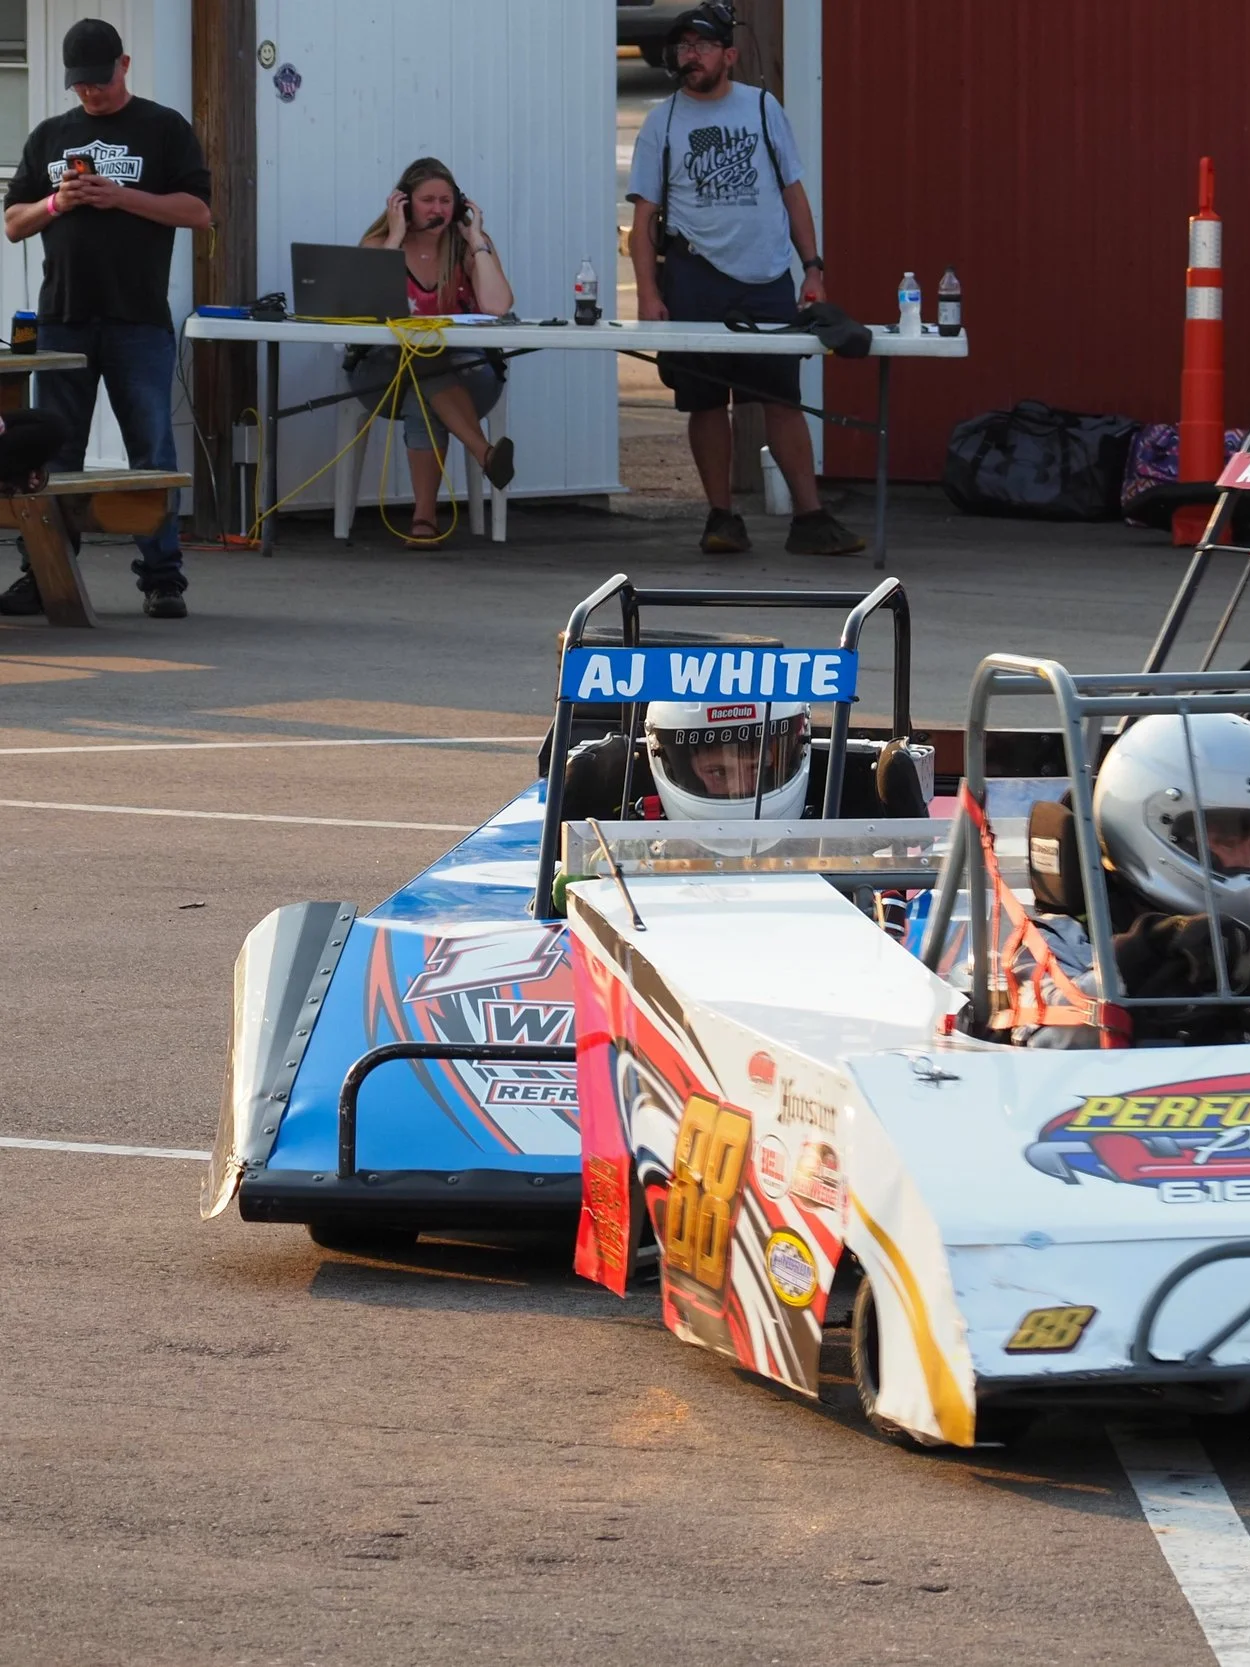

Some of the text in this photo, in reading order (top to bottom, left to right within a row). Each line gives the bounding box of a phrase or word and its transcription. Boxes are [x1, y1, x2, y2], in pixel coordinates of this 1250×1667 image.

[577, 651, 842, 700] AJ WHITE
[710, 705, 753, 720] RaceQuip
[1004, 1305, 1097, 1355] 88
